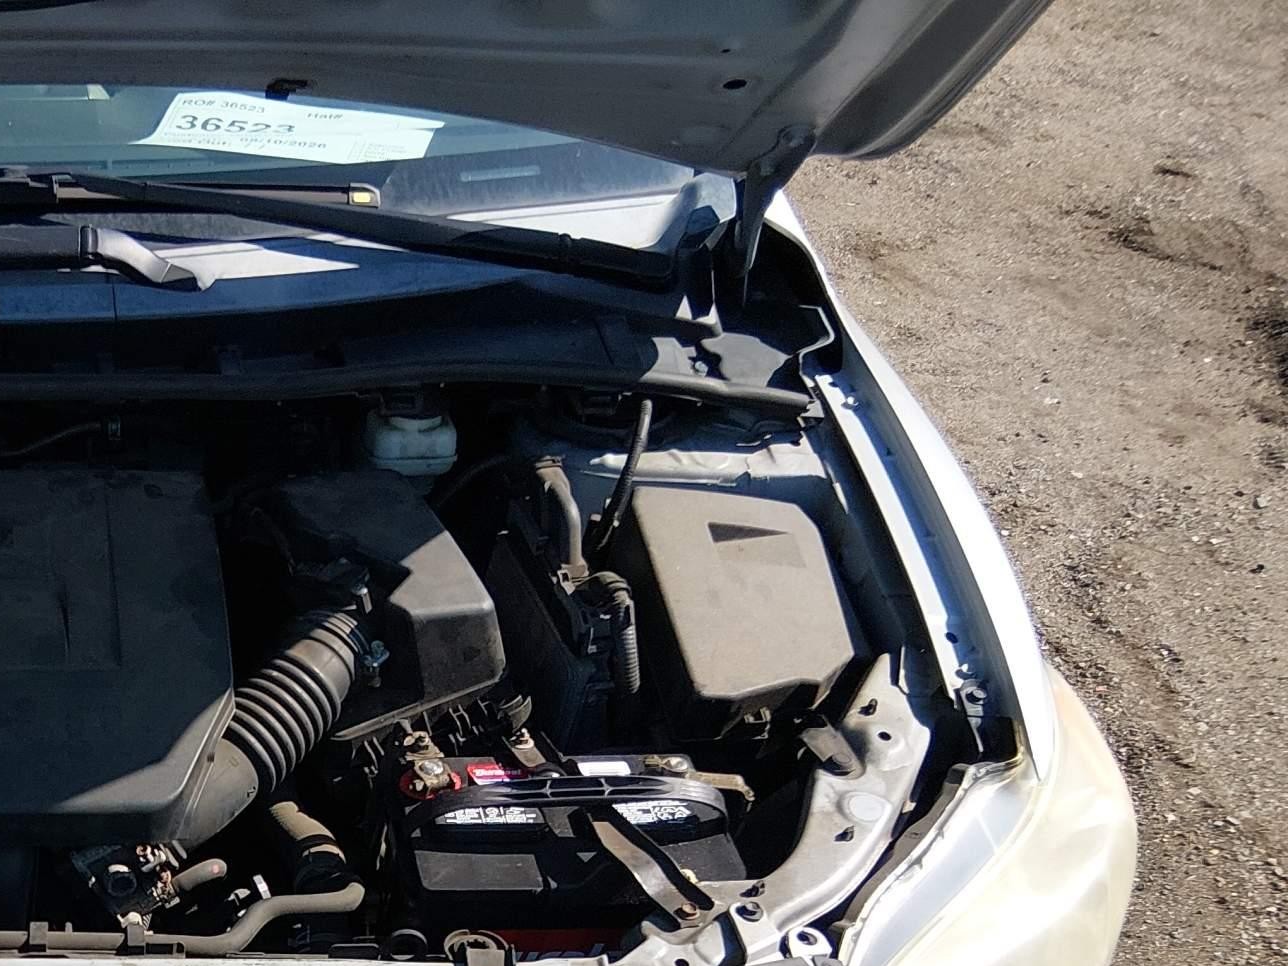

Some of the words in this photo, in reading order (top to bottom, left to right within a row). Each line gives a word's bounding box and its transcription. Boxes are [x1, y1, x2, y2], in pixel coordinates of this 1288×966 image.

[182, 99, 216, 107] RO#
[219, 100, 266, 113] 36523
[175, 114, 296, 133] 36523
